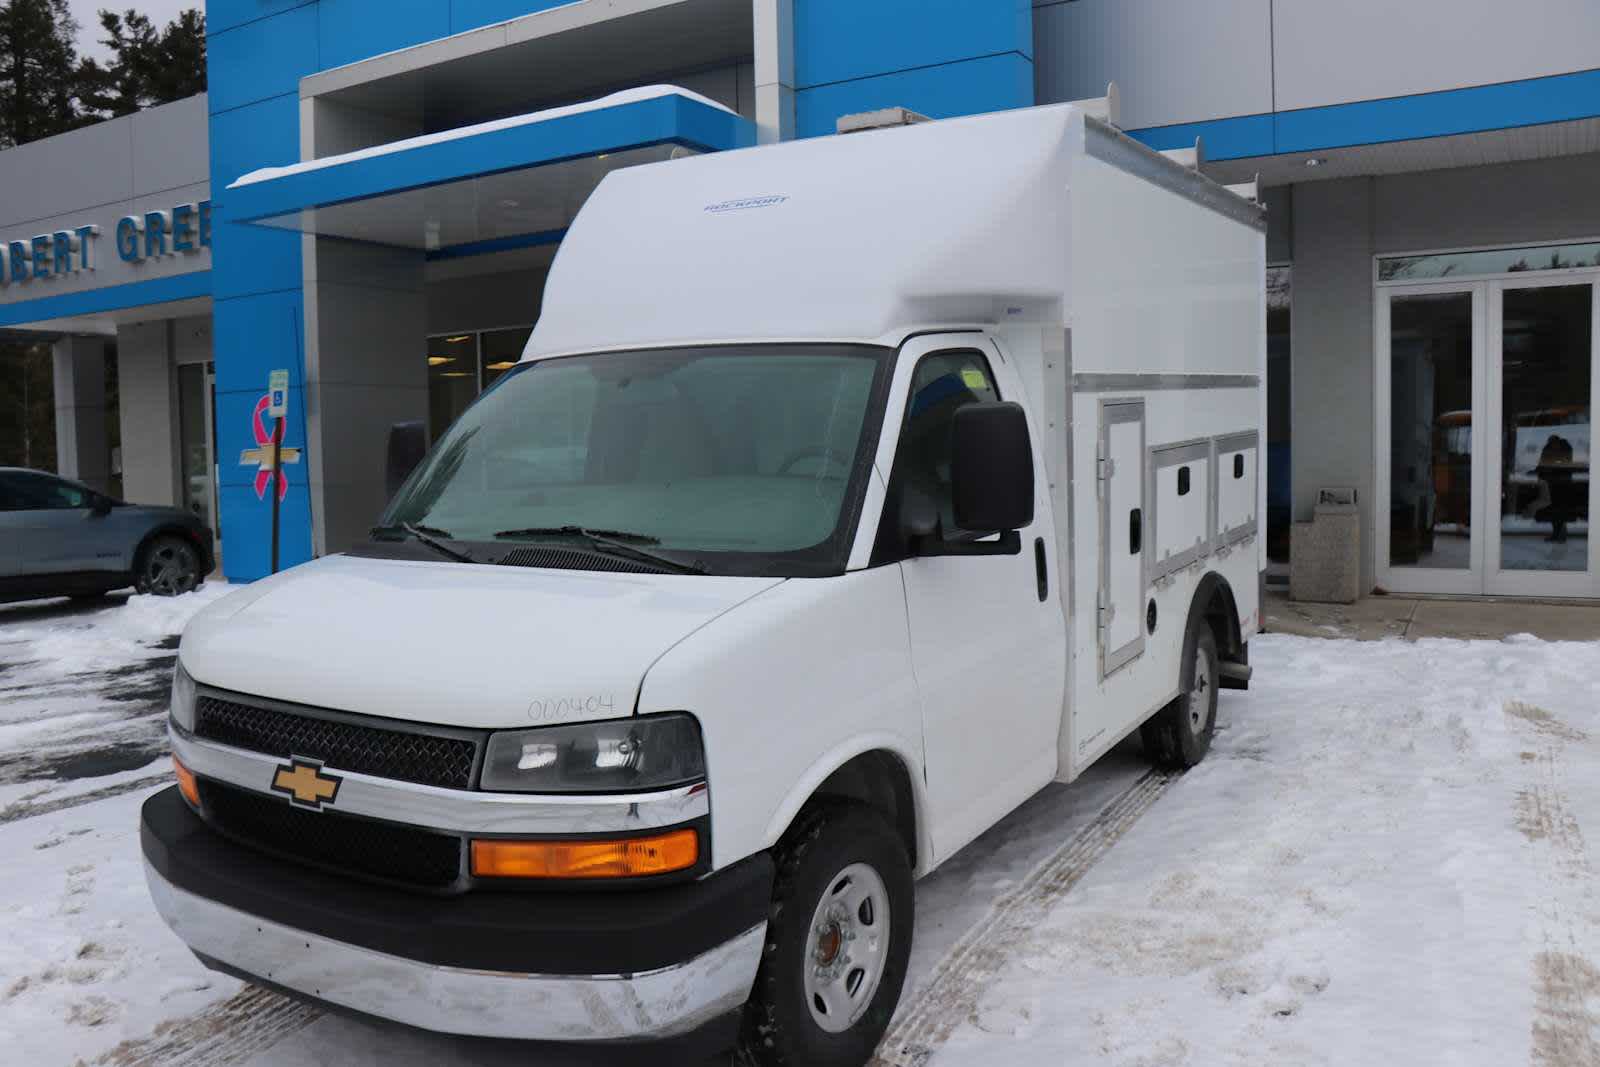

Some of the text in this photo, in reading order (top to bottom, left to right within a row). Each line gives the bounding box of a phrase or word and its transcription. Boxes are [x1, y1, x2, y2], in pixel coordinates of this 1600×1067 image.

[704, 196, 789, 212] ROCKPORT
[0, 224, 98, 284] BERT
[528, 695, 614, 720] 000404
